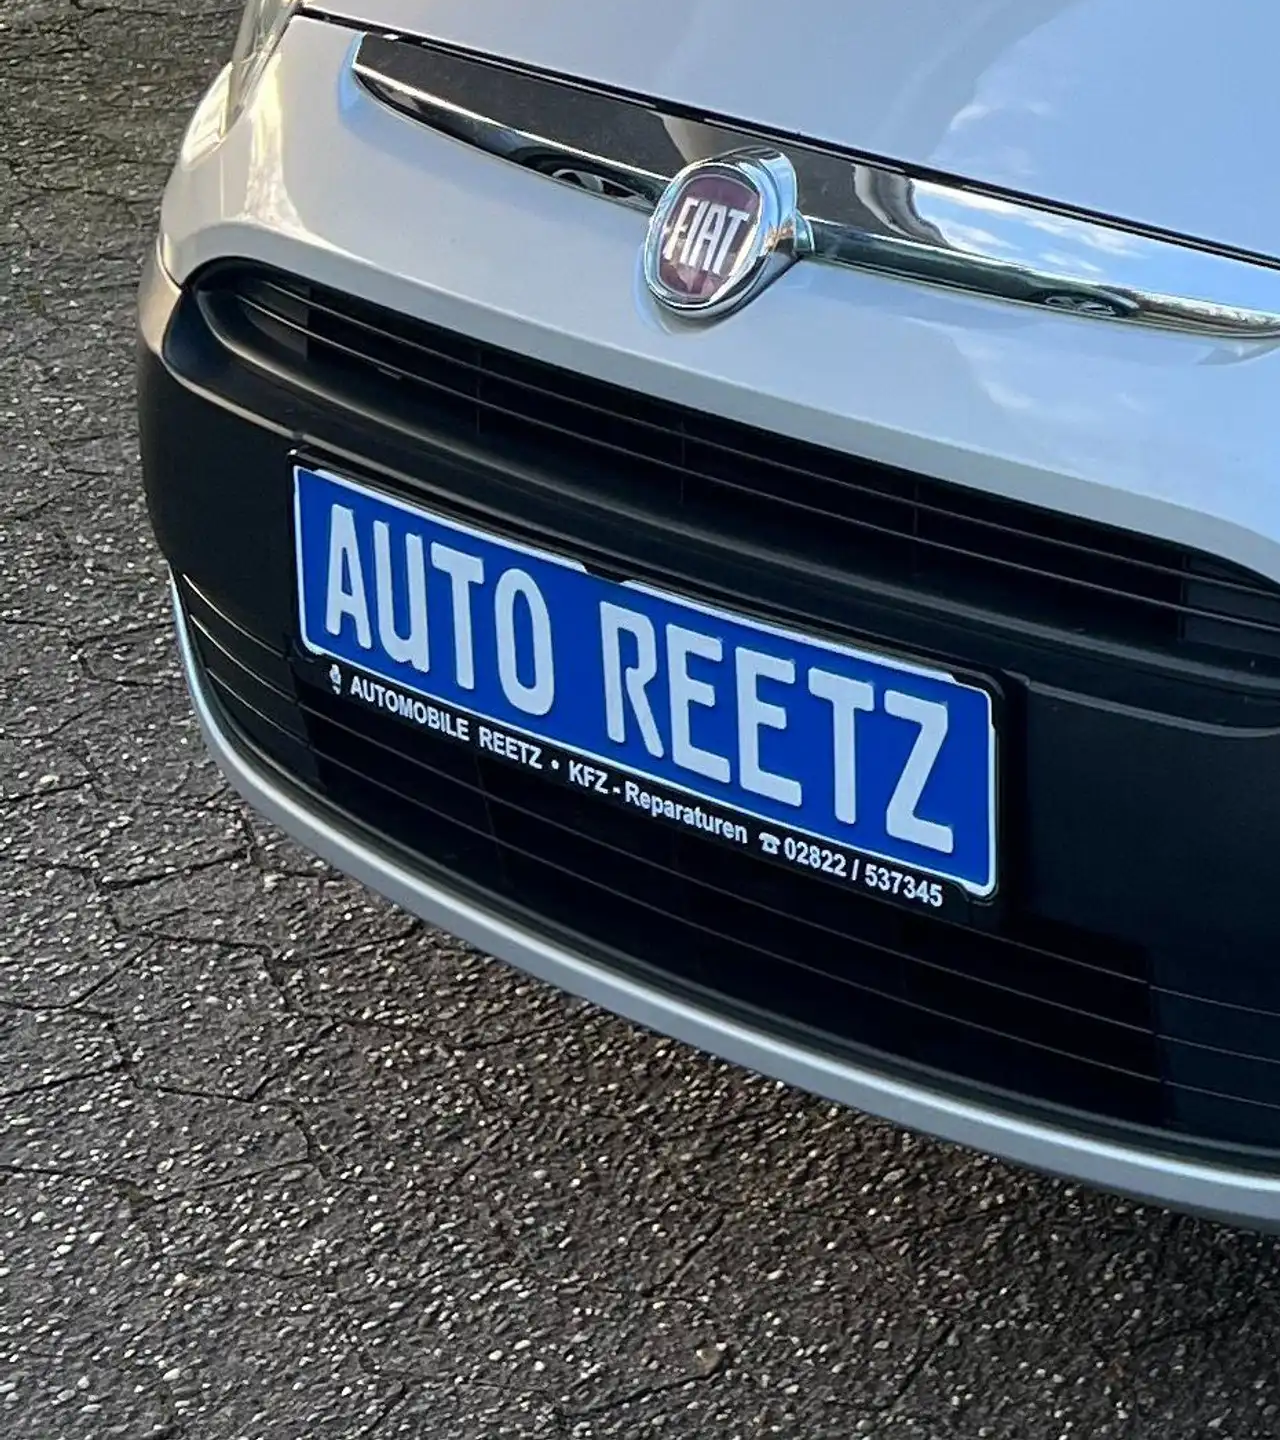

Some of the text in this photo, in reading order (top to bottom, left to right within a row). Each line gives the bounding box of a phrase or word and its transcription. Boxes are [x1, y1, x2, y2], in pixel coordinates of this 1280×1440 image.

[662, 196, 750, 277] FIAT
[325, 503, 954, 854] AUTO REETZ
[350, 675, 471, 742] AUTOMOBILE
[478, 725, 544, 770] REETZ
[568, 759, 609, 795] KFZ
[624, 780, 748, 844] Reparaturen
[784, 836, 847, 878] 02822
[865, 863, 943, 908] 537345
